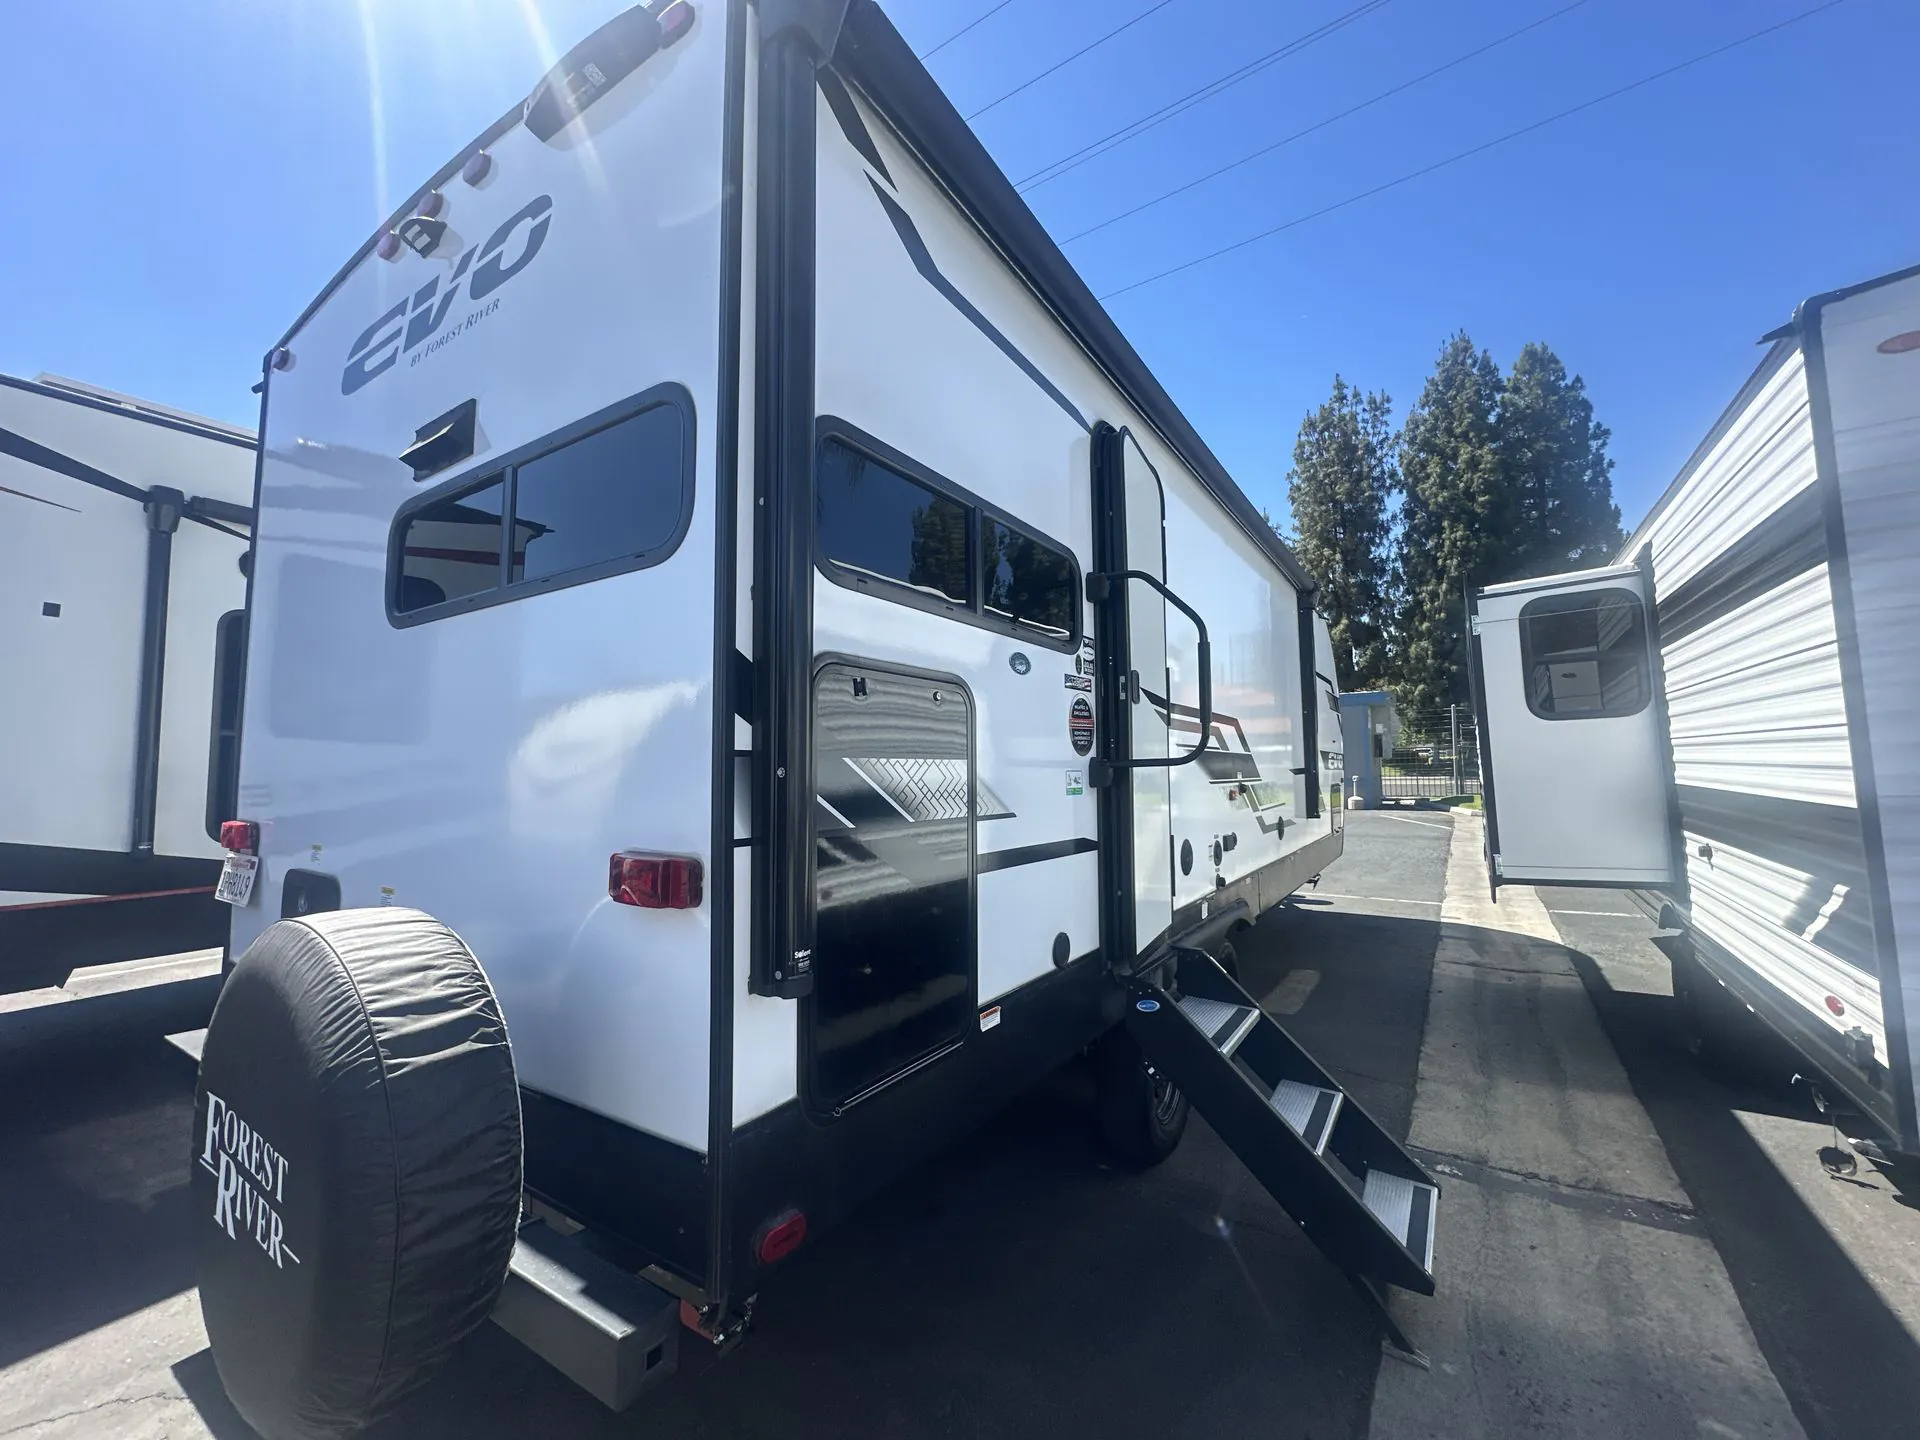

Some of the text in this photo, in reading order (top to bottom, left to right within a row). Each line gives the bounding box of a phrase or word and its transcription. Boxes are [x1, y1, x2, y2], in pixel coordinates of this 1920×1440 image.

[341, 194, 553, 396] EVO
[410, 298, 500, 367] BY FOREST RIVER
[202, 1091, 289, 1204] FOREST
[213, 1149, 283, 1269] RIVER
